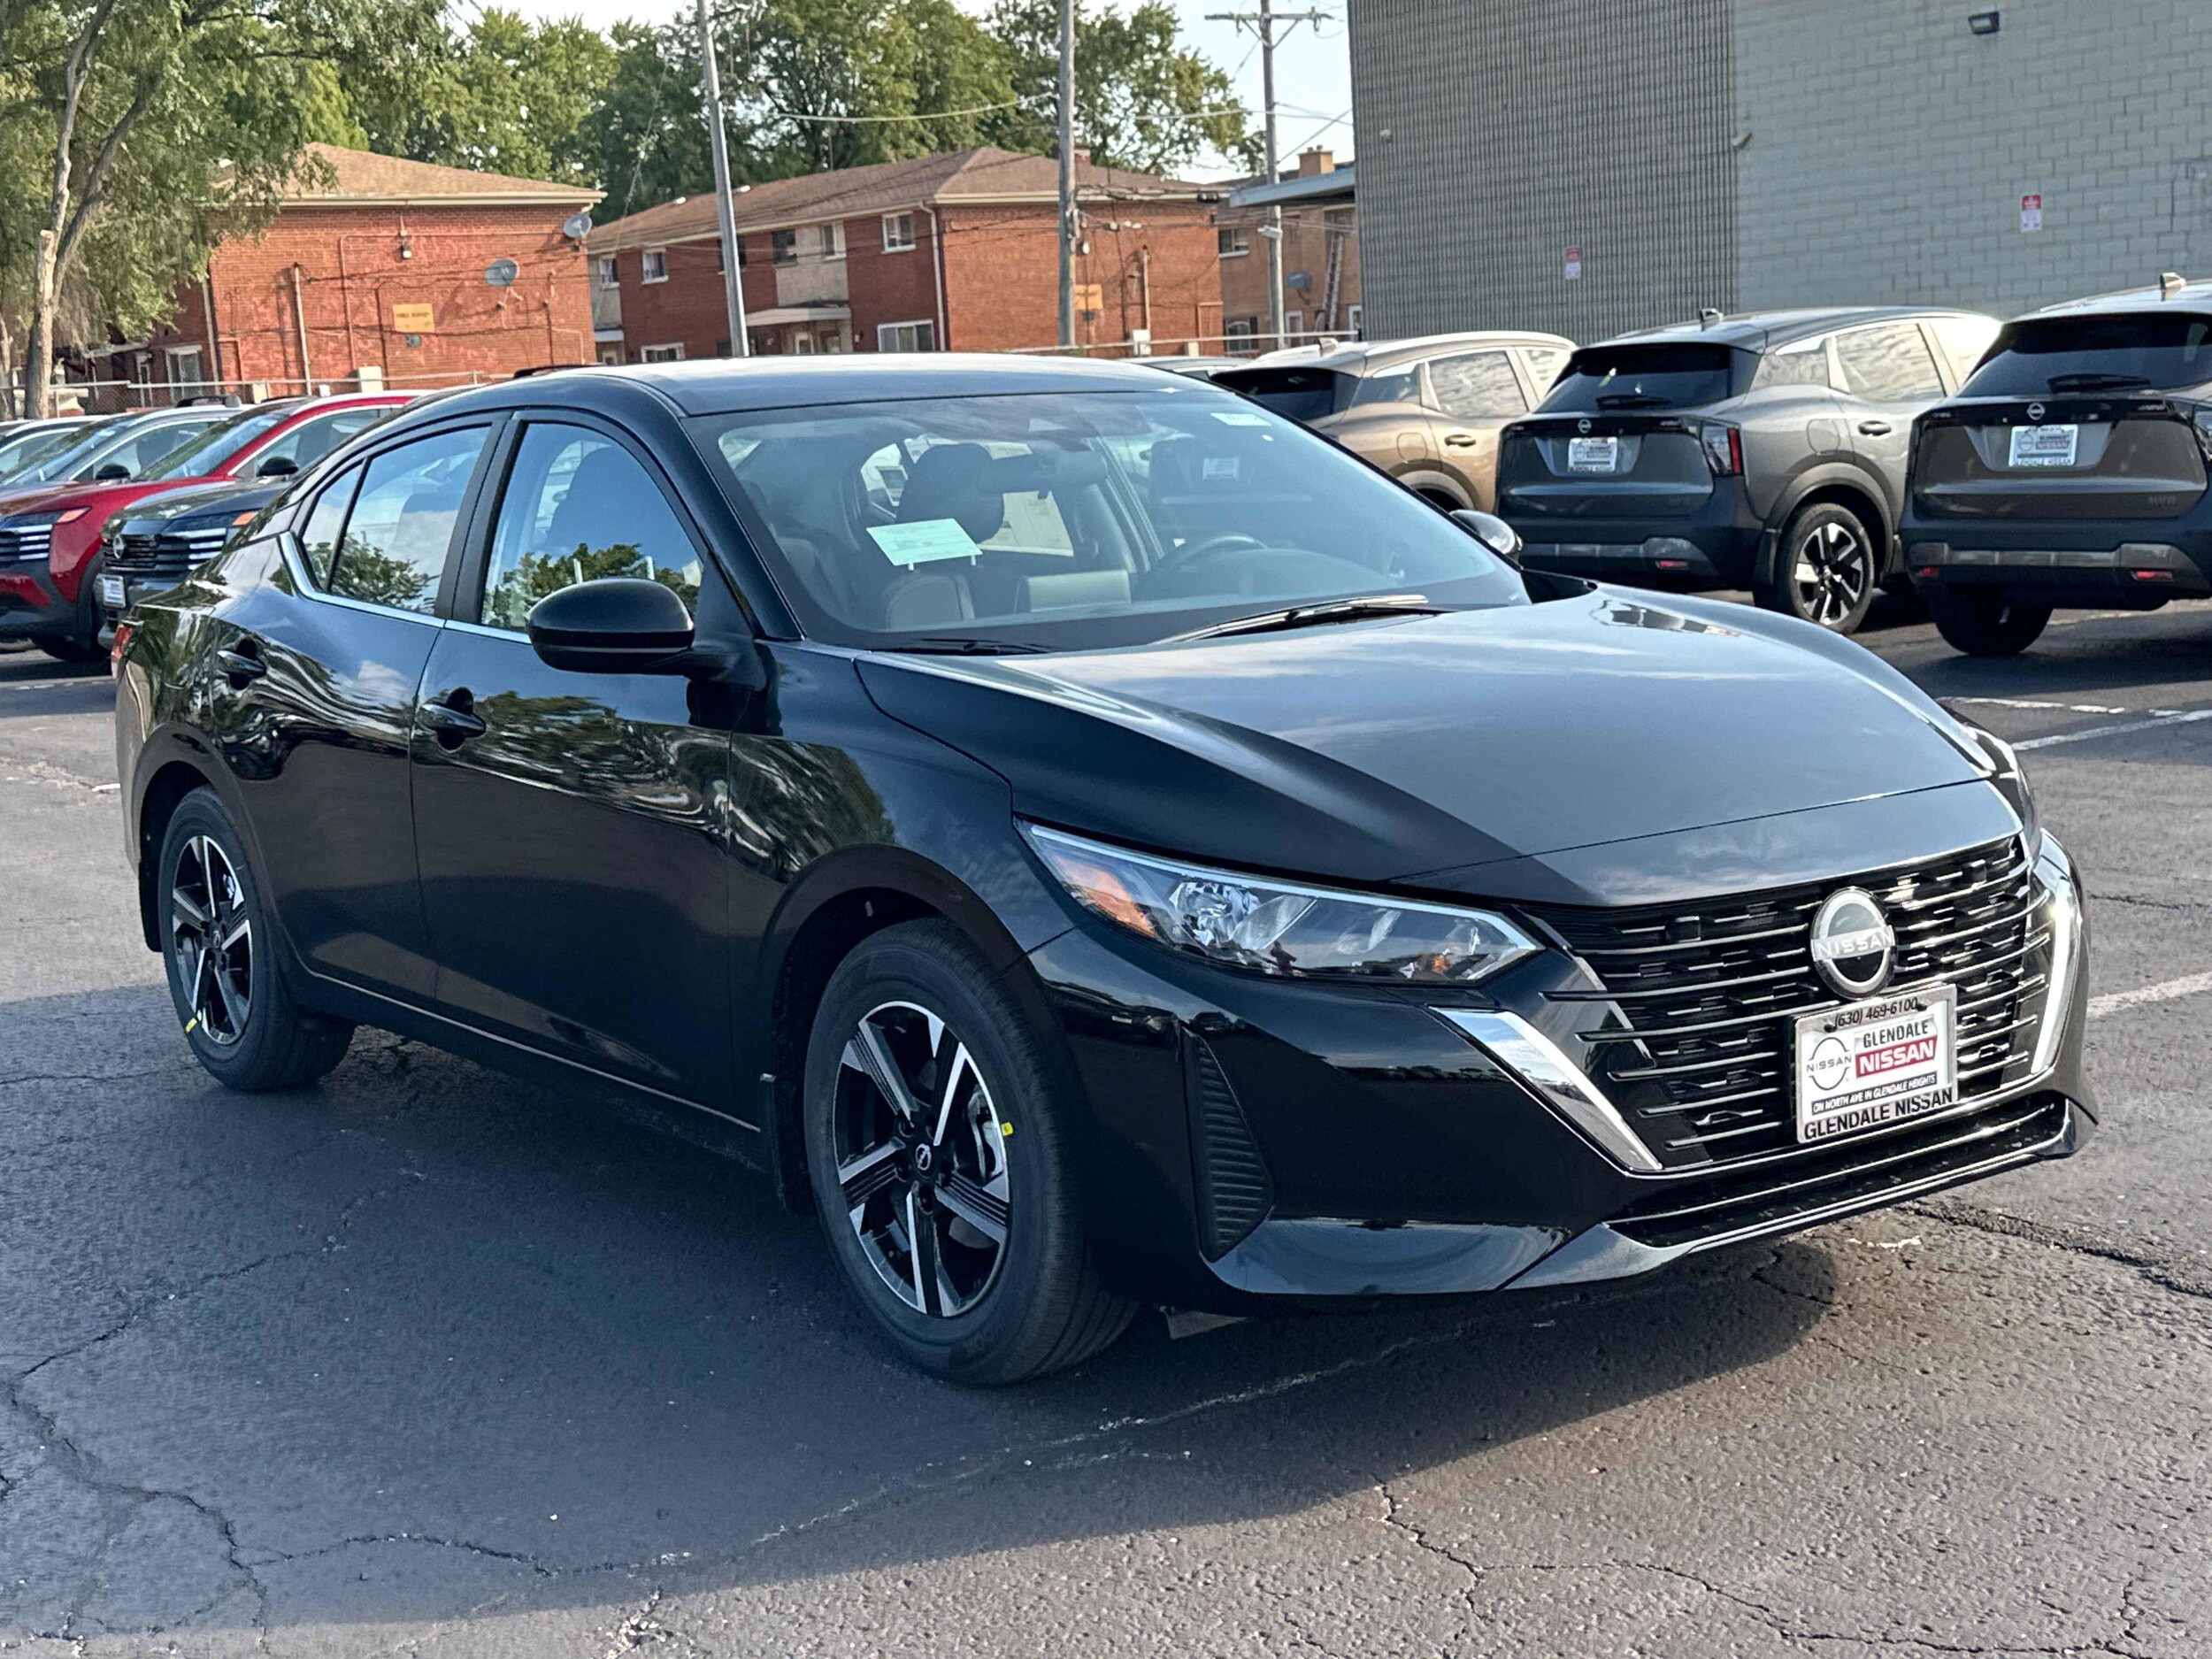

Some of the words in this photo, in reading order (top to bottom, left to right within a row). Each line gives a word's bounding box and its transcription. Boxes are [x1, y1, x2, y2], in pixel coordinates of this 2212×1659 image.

[1816, 930, 1893, 959] NISSAN
[1834, 1010, 1863, 1030] (630)
[1865, 997, 1918, 1019] 469-6100
[1863, 1020, 1928, 1048] GLENDALE
[1806, 1054, 1852, 1073] NISSAN
[1859, 1041, 1934, 1074] NISSAN
[1804, 1104, 1890, 1140] GLENDALE
[1895, 1087, 1953, 1117] NISSAN
